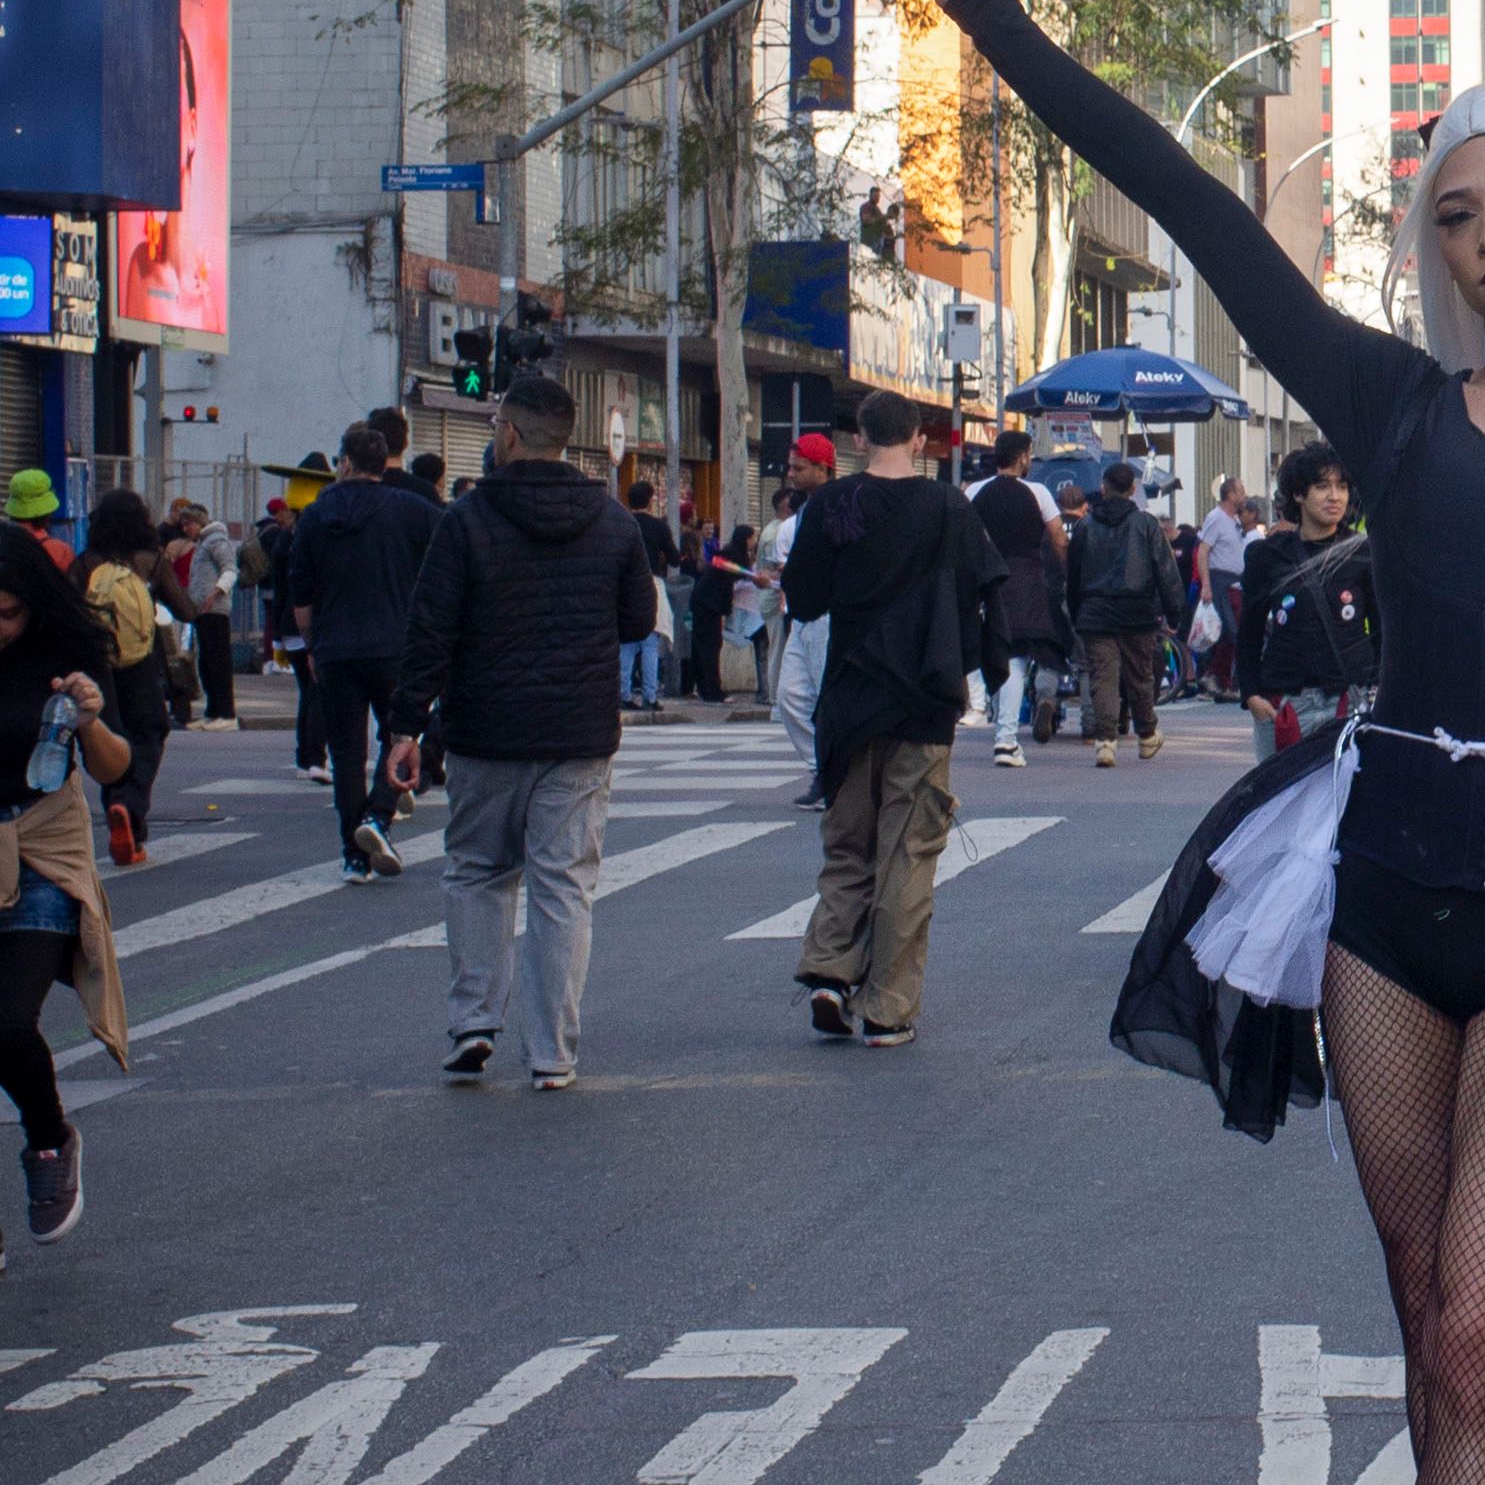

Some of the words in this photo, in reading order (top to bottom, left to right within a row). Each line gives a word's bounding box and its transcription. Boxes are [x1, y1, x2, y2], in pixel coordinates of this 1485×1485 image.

[56, 229, 97, 267] SOM
[12, 273, 27, 286] de
[1135, 370, 1184, 383] Ateky
